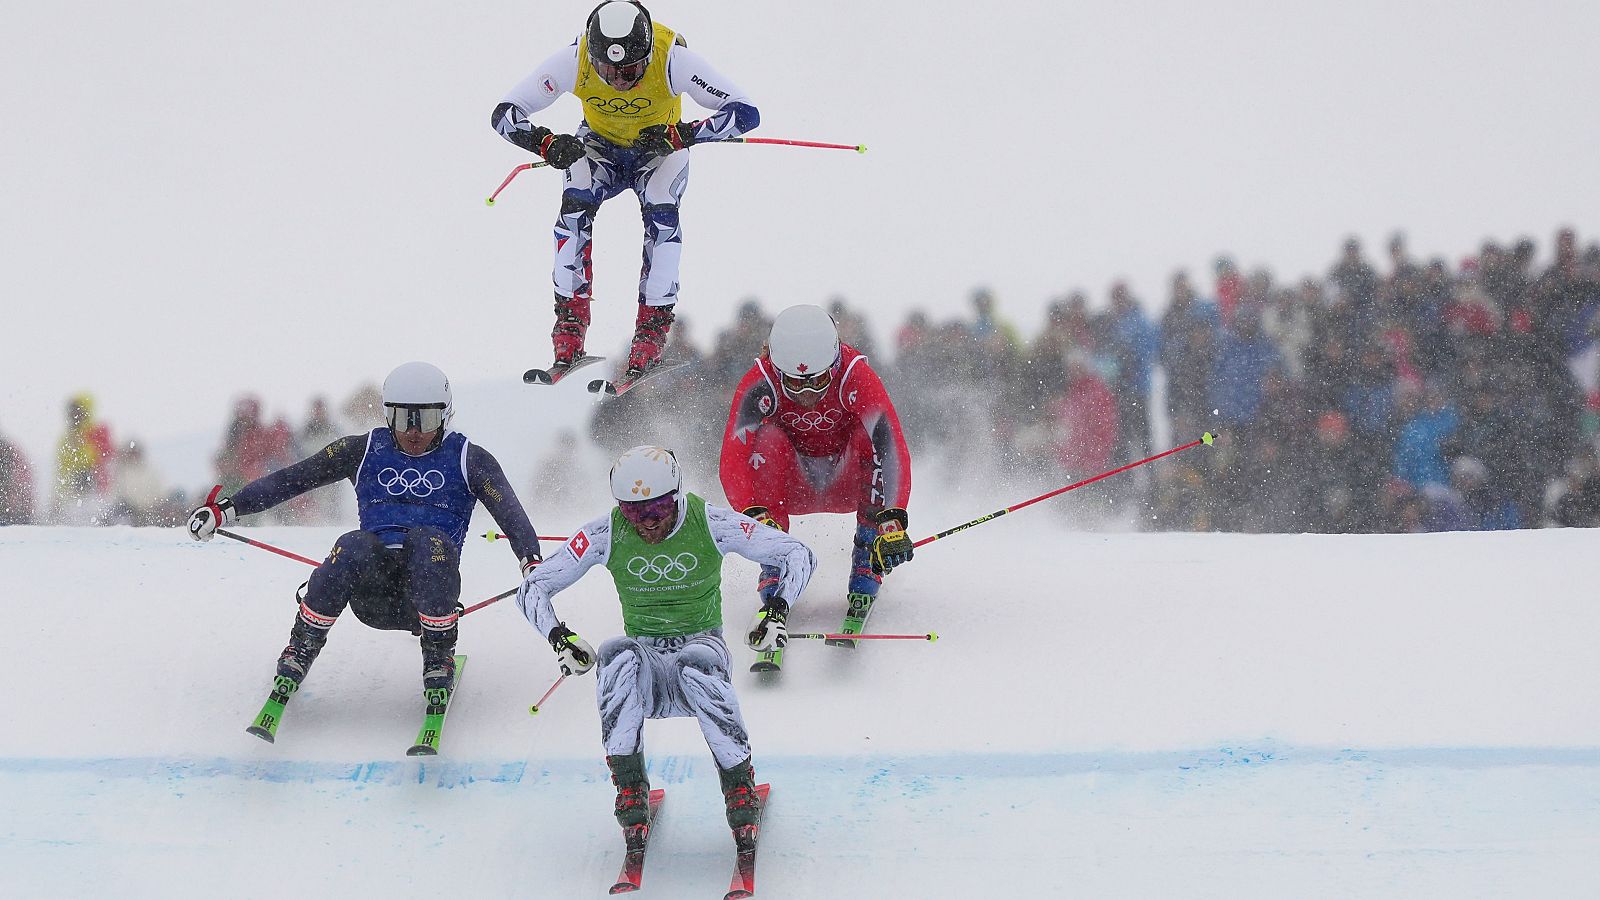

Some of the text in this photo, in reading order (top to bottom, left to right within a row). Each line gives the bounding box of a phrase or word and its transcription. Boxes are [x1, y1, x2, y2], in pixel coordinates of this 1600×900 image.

[690, 74, 730, 100] DON QUIET
[431, 554, 446, 563] SWE
[656, 583, 689, 592] CORTINA
